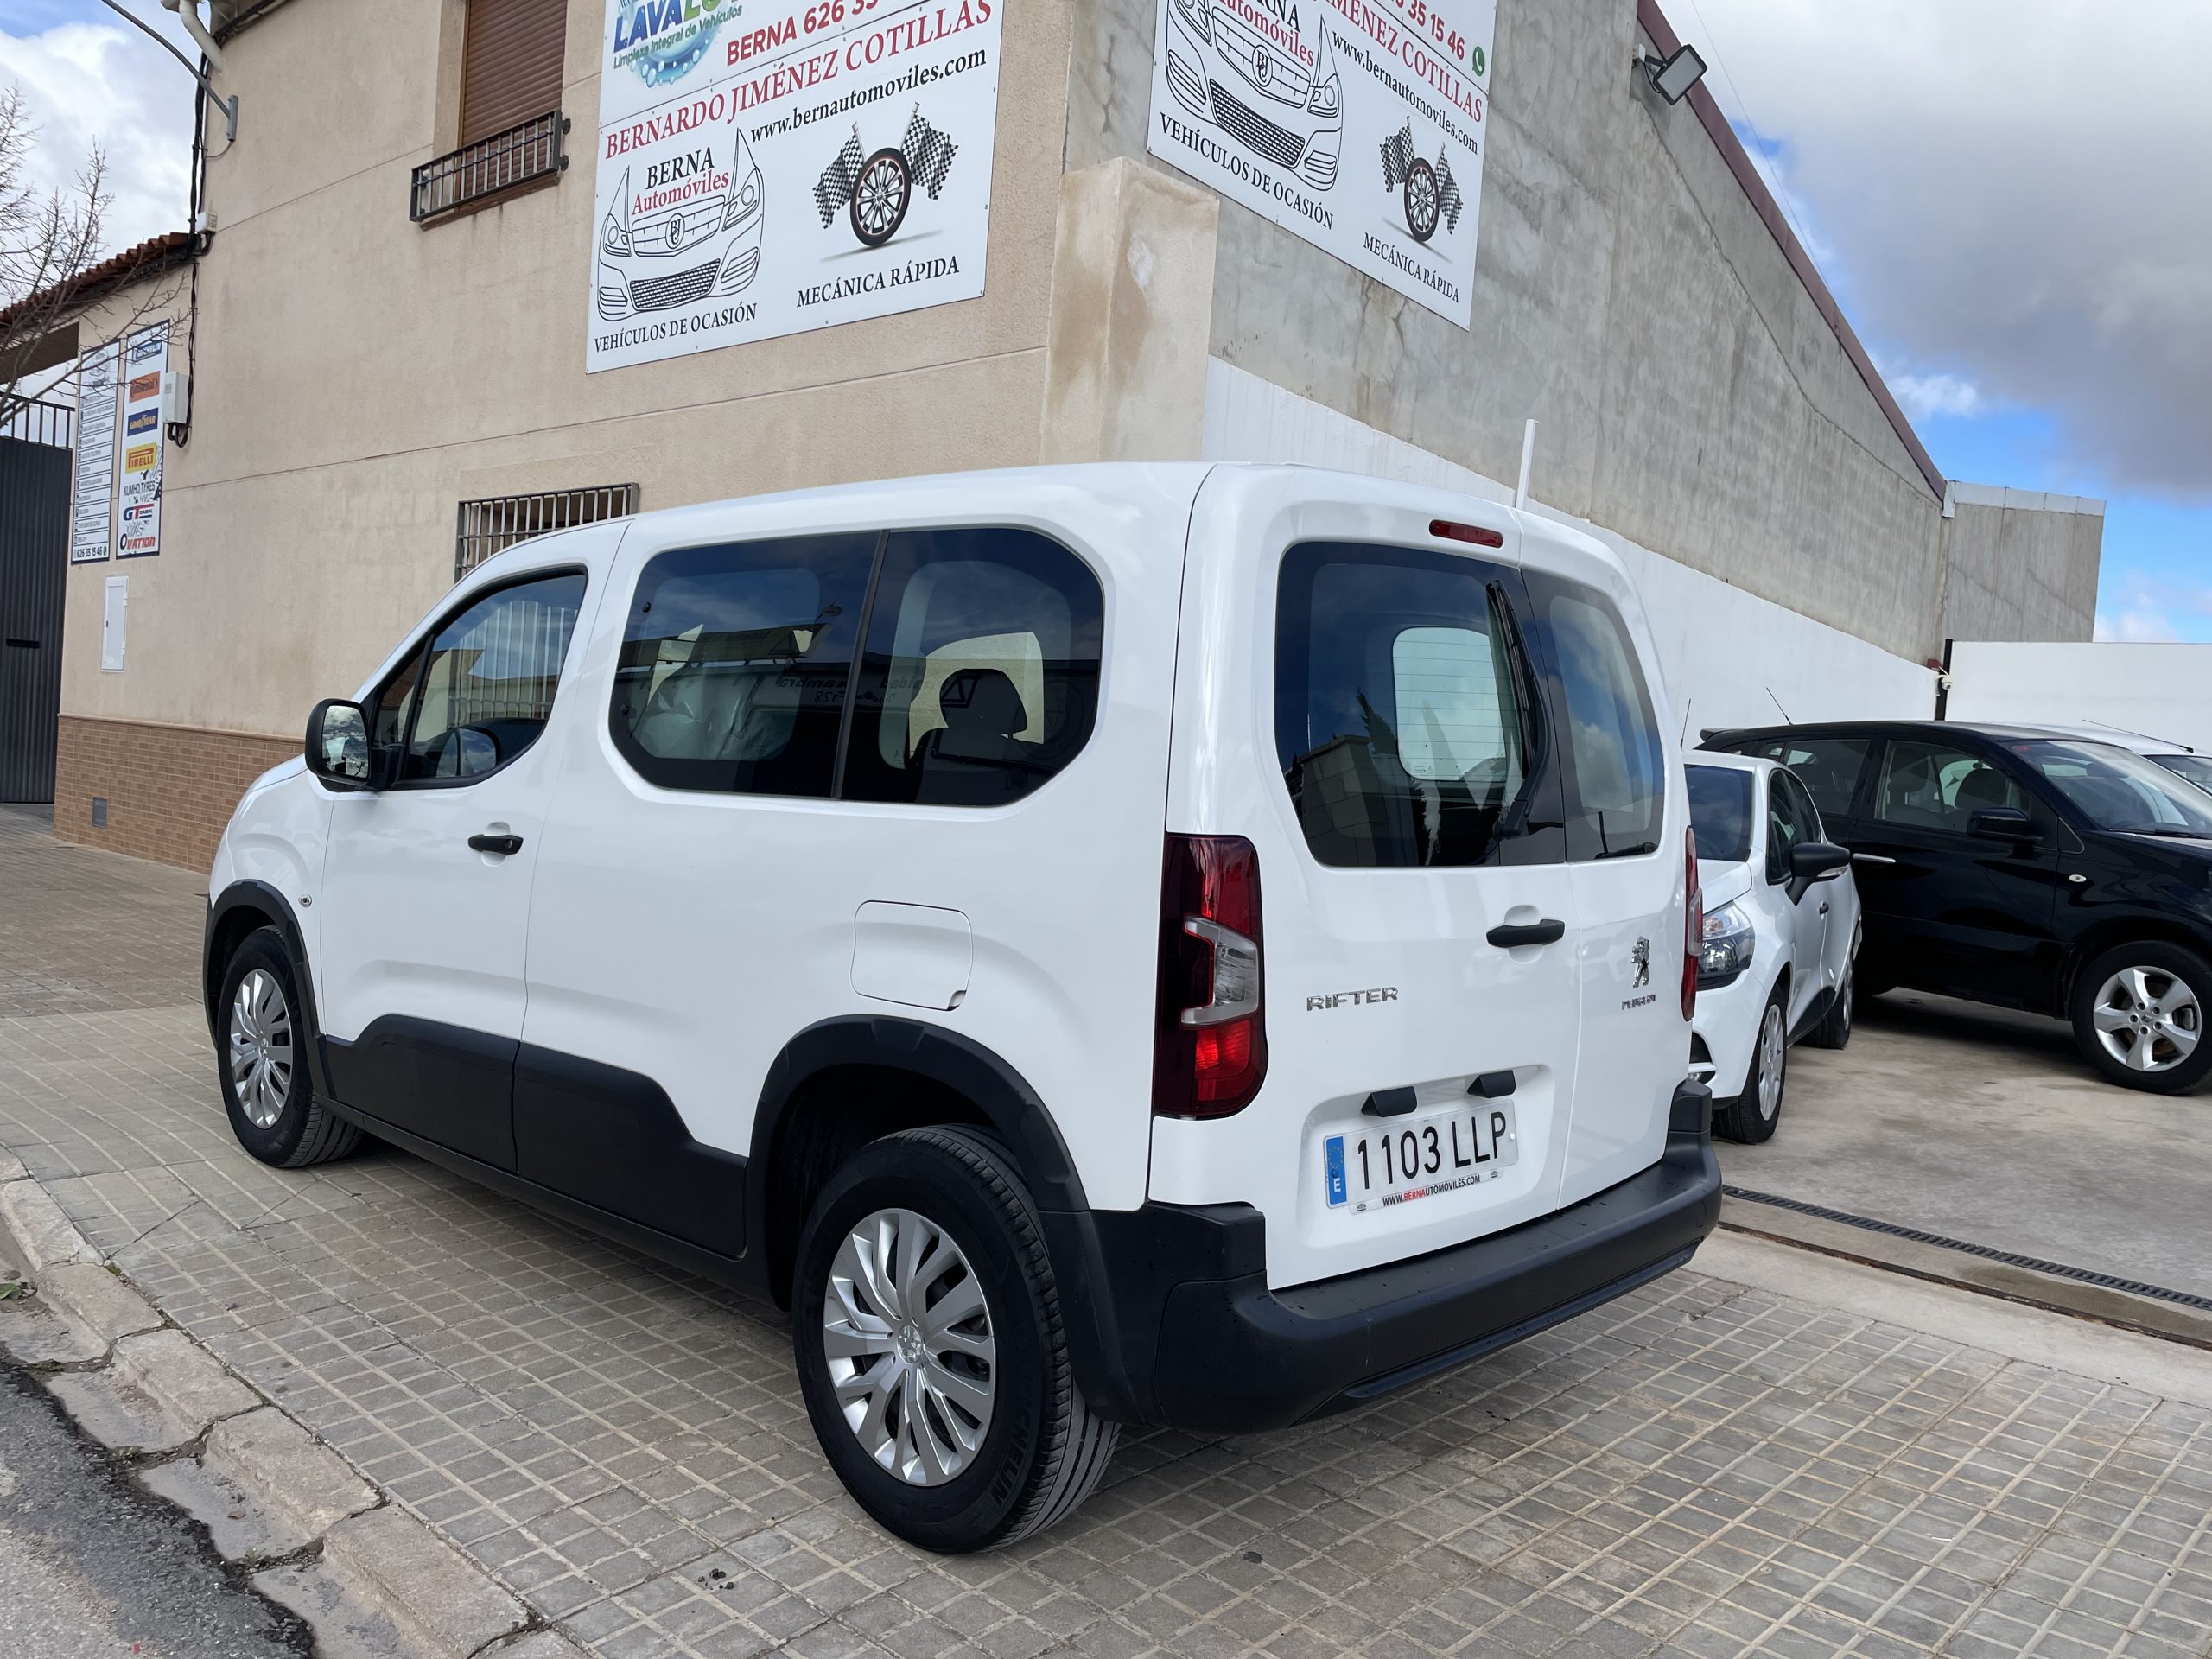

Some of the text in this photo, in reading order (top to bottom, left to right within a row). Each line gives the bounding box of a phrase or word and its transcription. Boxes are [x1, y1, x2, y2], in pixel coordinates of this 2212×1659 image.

[613, 4, 742, 70] Limpieza Integral de Vehículos
[727, 16, 797, 67] BERNA
[804, 0, 845, 35] 626
[1219, 0, 1314, 67] utomóviles
[1408, 0, 1465, 60] 35 15 46
[605, 0, 992, 159] BERNARDO JIMÉNEZ COTILLAS
[751, 48, 987, 143] www.bernautomoviles.com
[1332, 31, 1478, 156] www.bernautomoviles.com
[1402, 41, 1482, 123] COTILLAS
[632, 169, 729, 216] Automóviles
[645, 147, 715, 190] BERNA
[1160, 111, 1334, 231] VEHÍCULOS DE OCASIÓN
[797, 256, 960, 308] MECÁNICA RÁPIDA
[1363, 232, 1459, 303] MECÁNICA RÁPIDA
[594, 302, 757, 353] VEHÍCULOS DE OCASIÓN
[128, 448, 154, 469] PIRELLI
[120, 533, 156, 550] OVATION
[1306, 987, 1398, 1011] RIFTER
[1357, 1111, 1507, 1190] 1103 LLP
[1333, 1178, 1342, 1192] E
[1382, 1174, 1480, 1207] WWW.BERNAUTOMOVILES.COM
